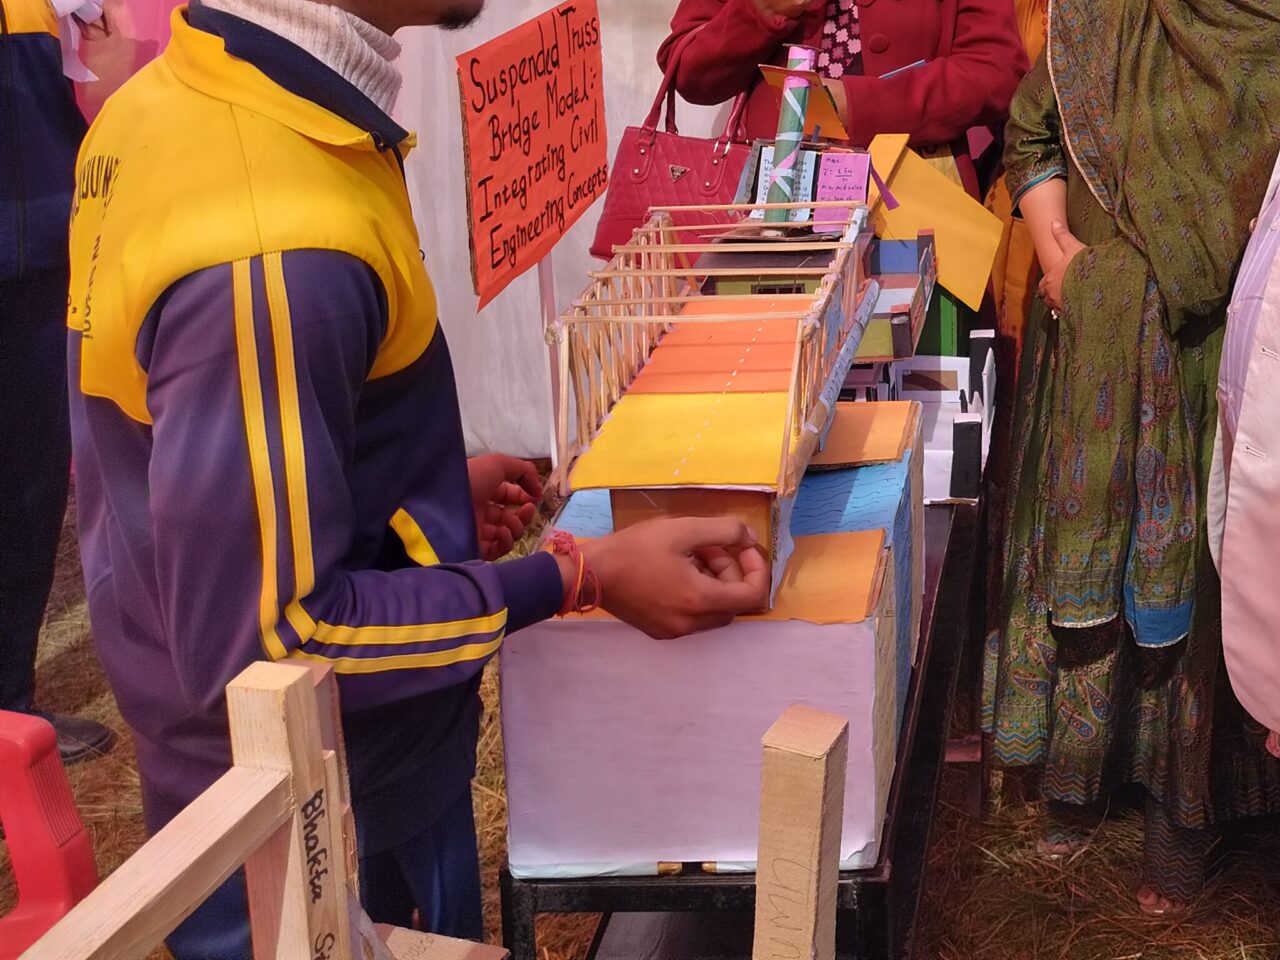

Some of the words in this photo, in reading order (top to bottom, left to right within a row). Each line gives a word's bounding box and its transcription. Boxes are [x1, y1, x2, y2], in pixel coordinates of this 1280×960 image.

[470, 12, 561, 113] Suspended
[557, 6, 599, 59] Truss
[477, 144, 565, 223] Integrating
[570, 98, 600, 154] Civil
[490, 198, 565, 270] Engineering
[566, 165, 608, 210] Concepts
[301, 788, 329, 904] Bhakta
